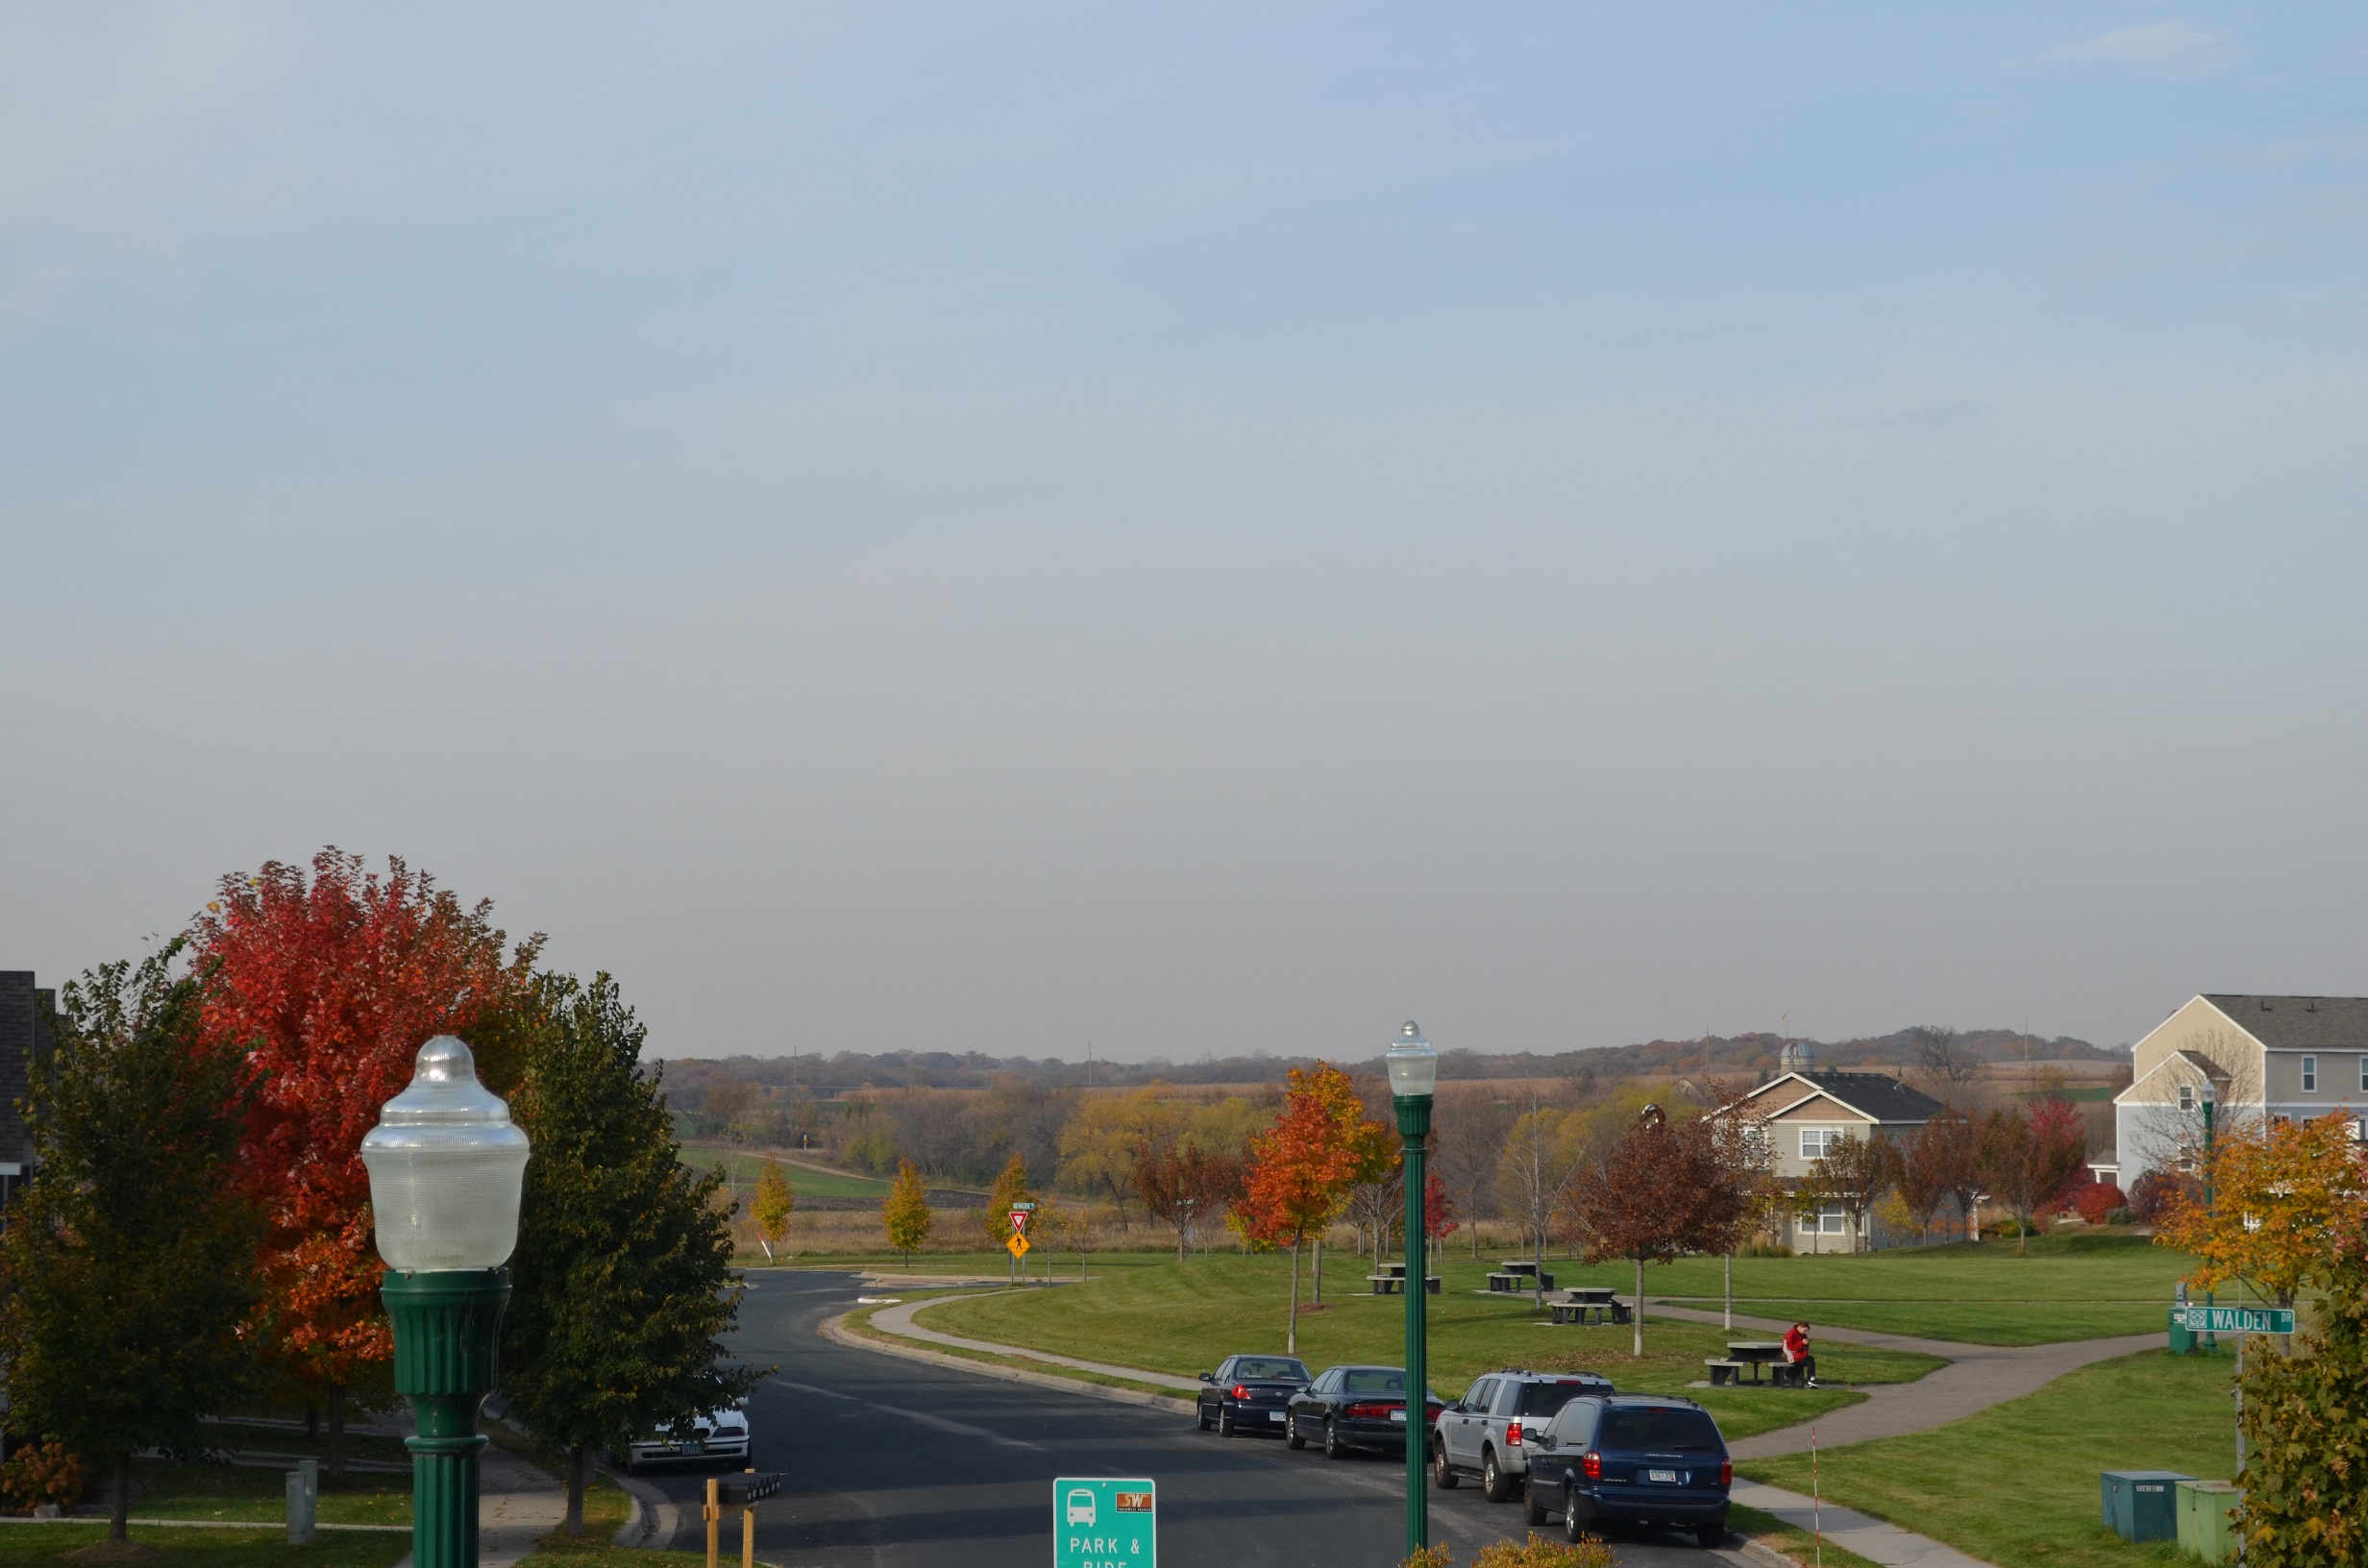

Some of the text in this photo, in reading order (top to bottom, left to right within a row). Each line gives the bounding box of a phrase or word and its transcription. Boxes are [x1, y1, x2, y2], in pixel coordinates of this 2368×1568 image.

[2211, 1310, 2292, 1331] WALDEN DR
[1118, 1494, 1149, 1507] SW
[1070, 1537, 1140, 1555] PARK &
